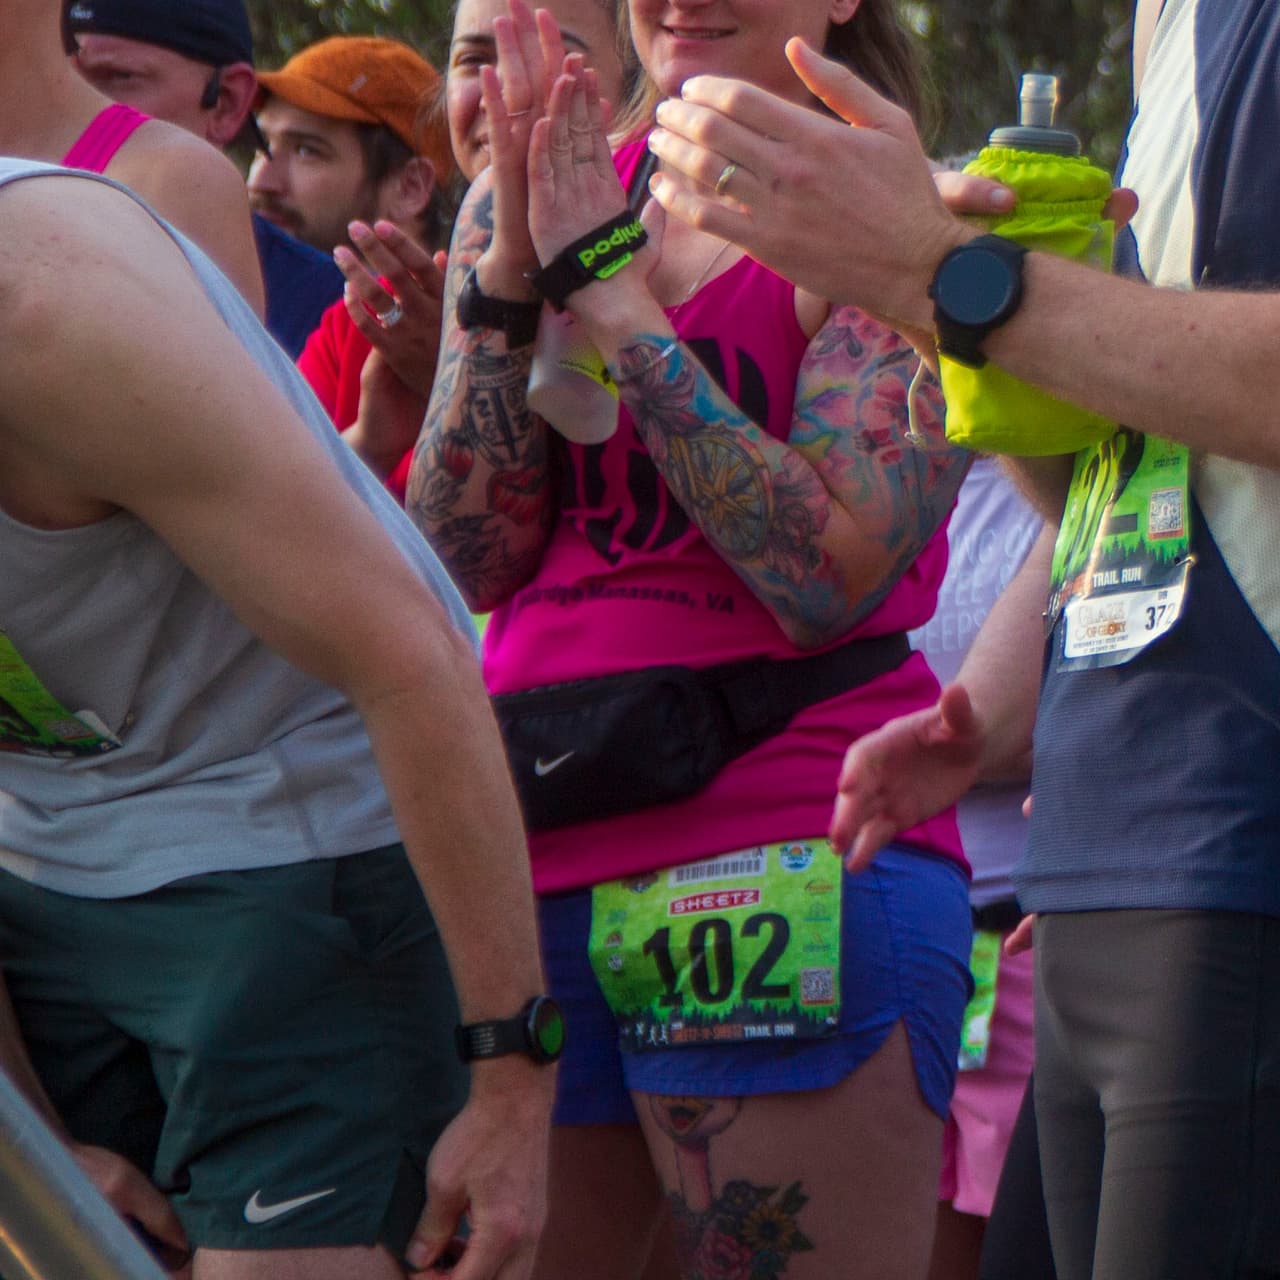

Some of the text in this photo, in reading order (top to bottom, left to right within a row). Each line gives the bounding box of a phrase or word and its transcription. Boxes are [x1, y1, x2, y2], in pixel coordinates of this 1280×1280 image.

[1093, 567, 1142, 588] TRAIL RUN
[706, 592, 735, 614] VA
[674, 891, 754, 913] SHEETZ
[643, 912, 790, 1007] 102
[744, 1024, 770, 1038] TRAIL
[774, 1023, 794, 1036] RUN
